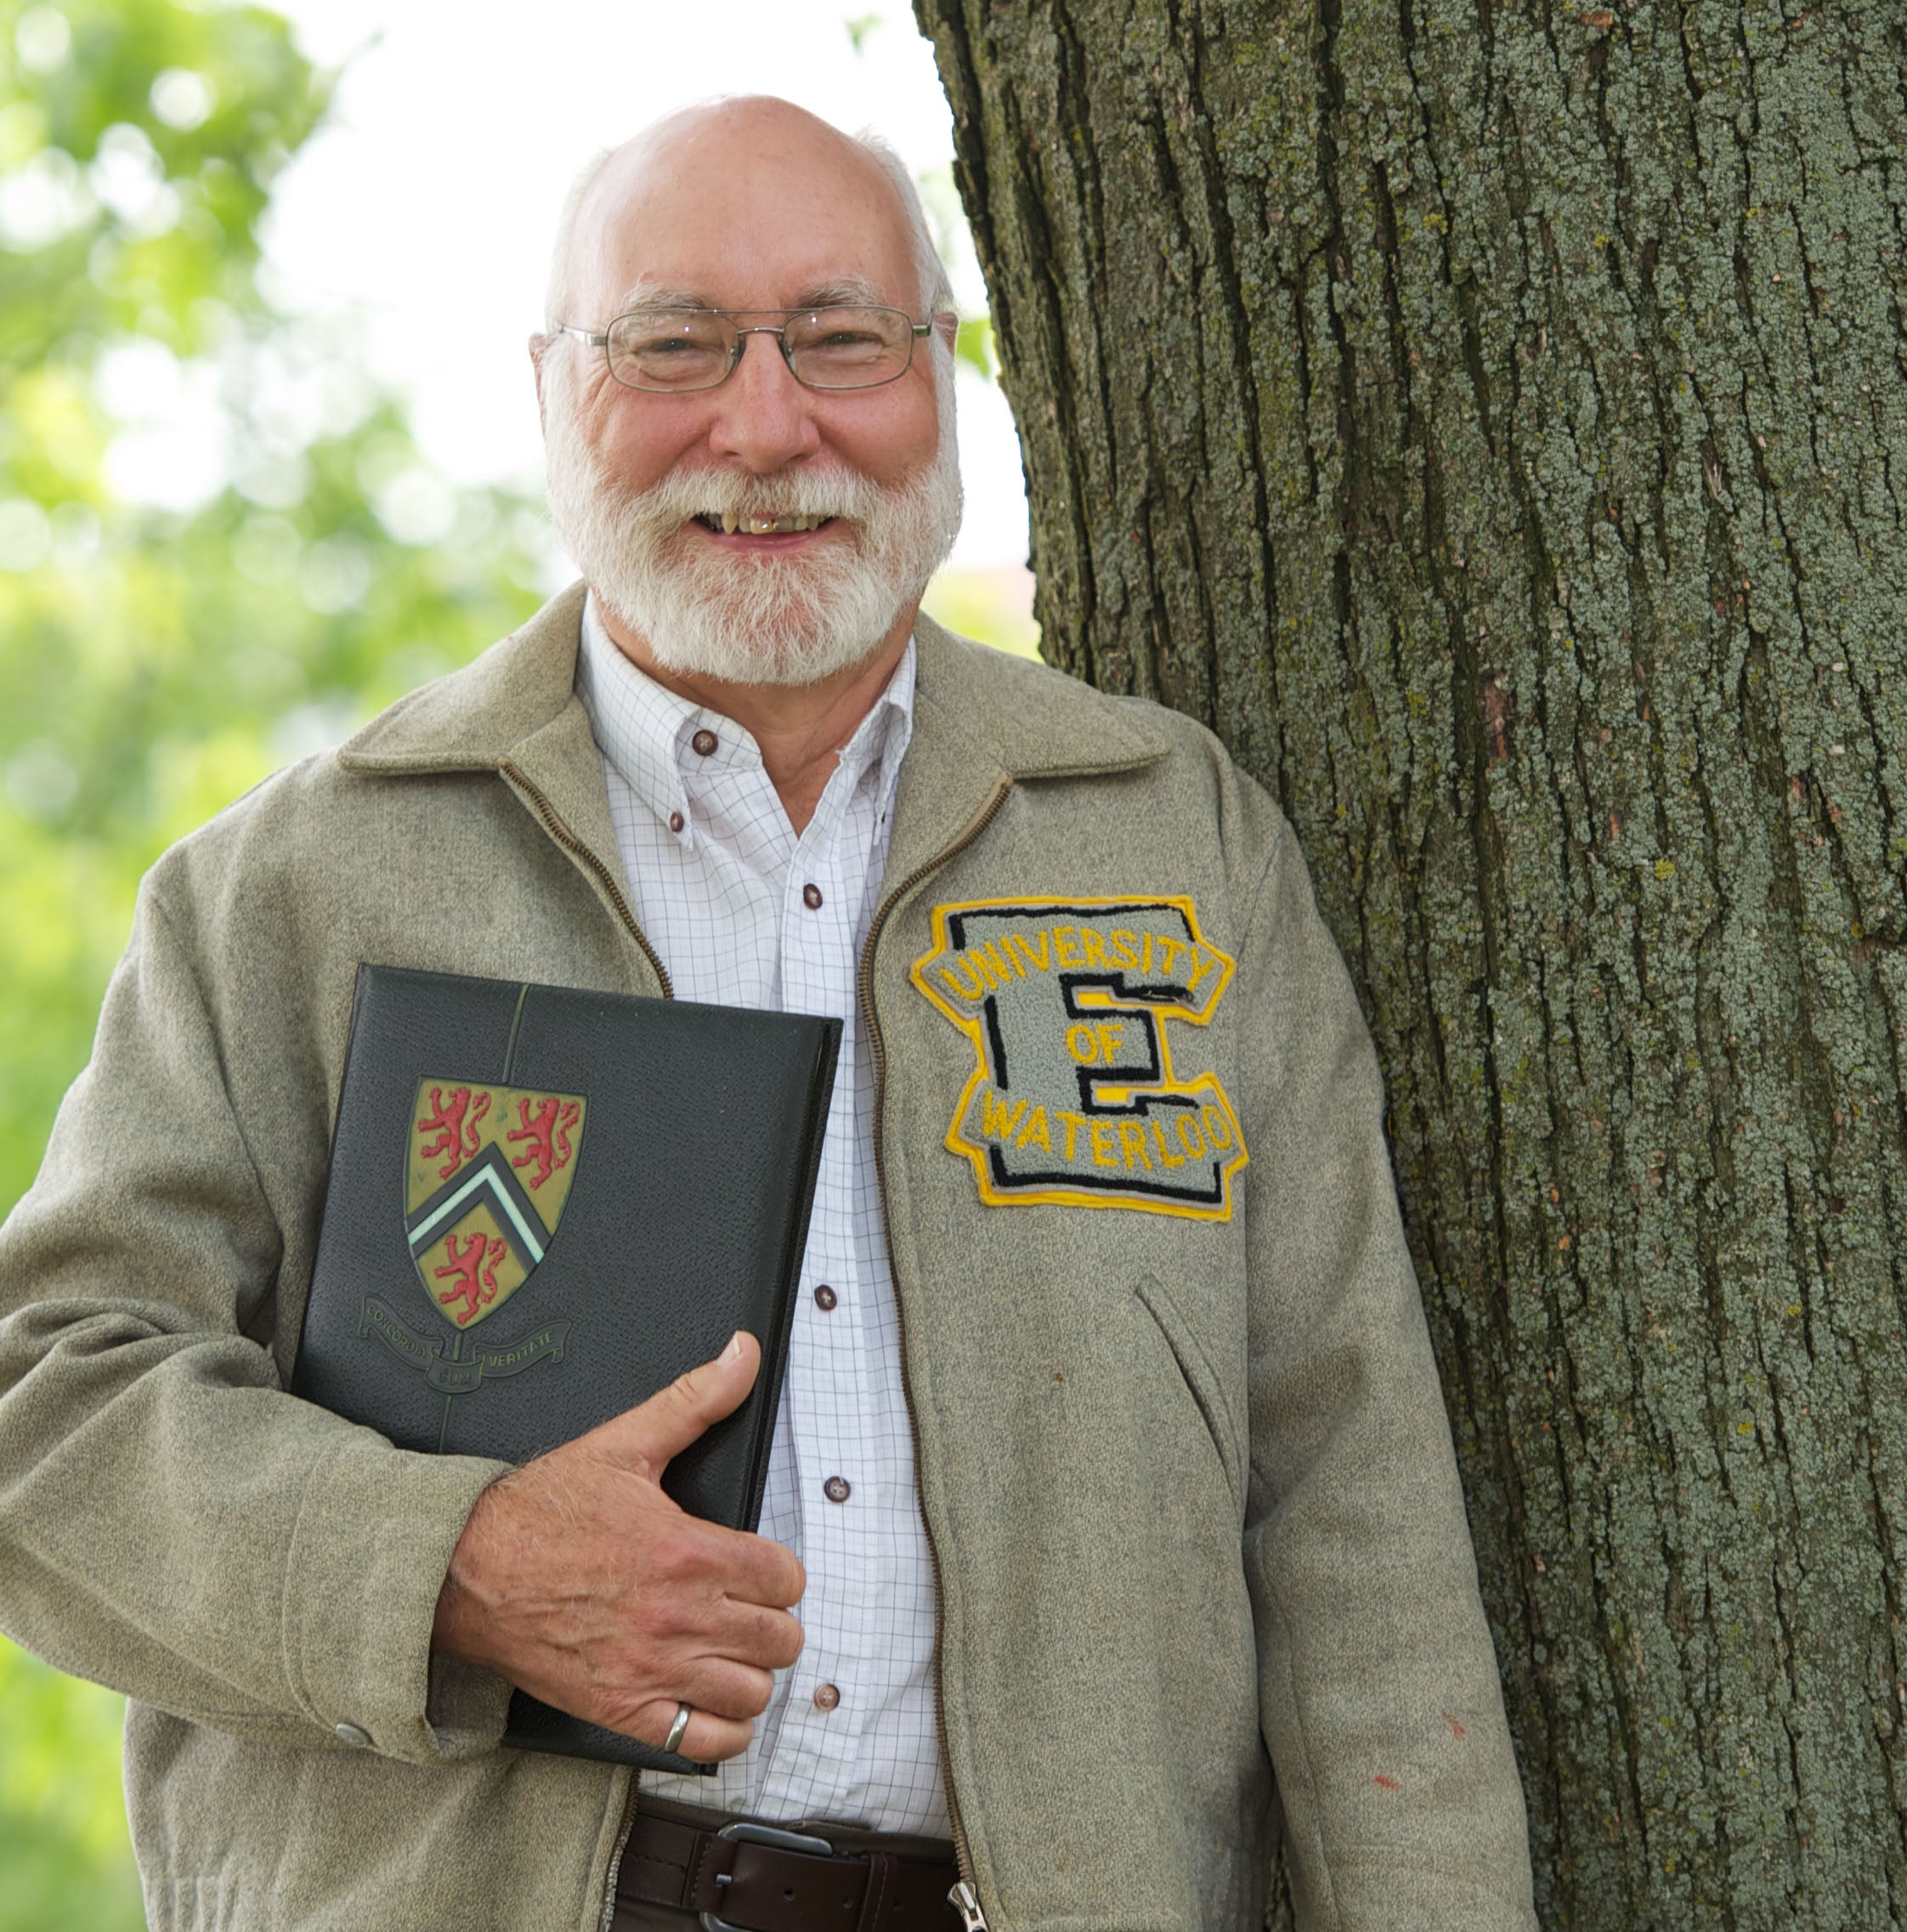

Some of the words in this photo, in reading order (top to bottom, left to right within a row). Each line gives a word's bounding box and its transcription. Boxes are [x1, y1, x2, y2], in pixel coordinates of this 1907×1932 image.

[939, 926, 1214, 1000] UNIVERSITY
[1066, 1023, 1123, 1065] OF
[982, 1091, 1232, 1170] WATERLOO
[367, 1305, 426, 1357] CONCORDIA
[489, 1331, 555, 1368] VERITATE
